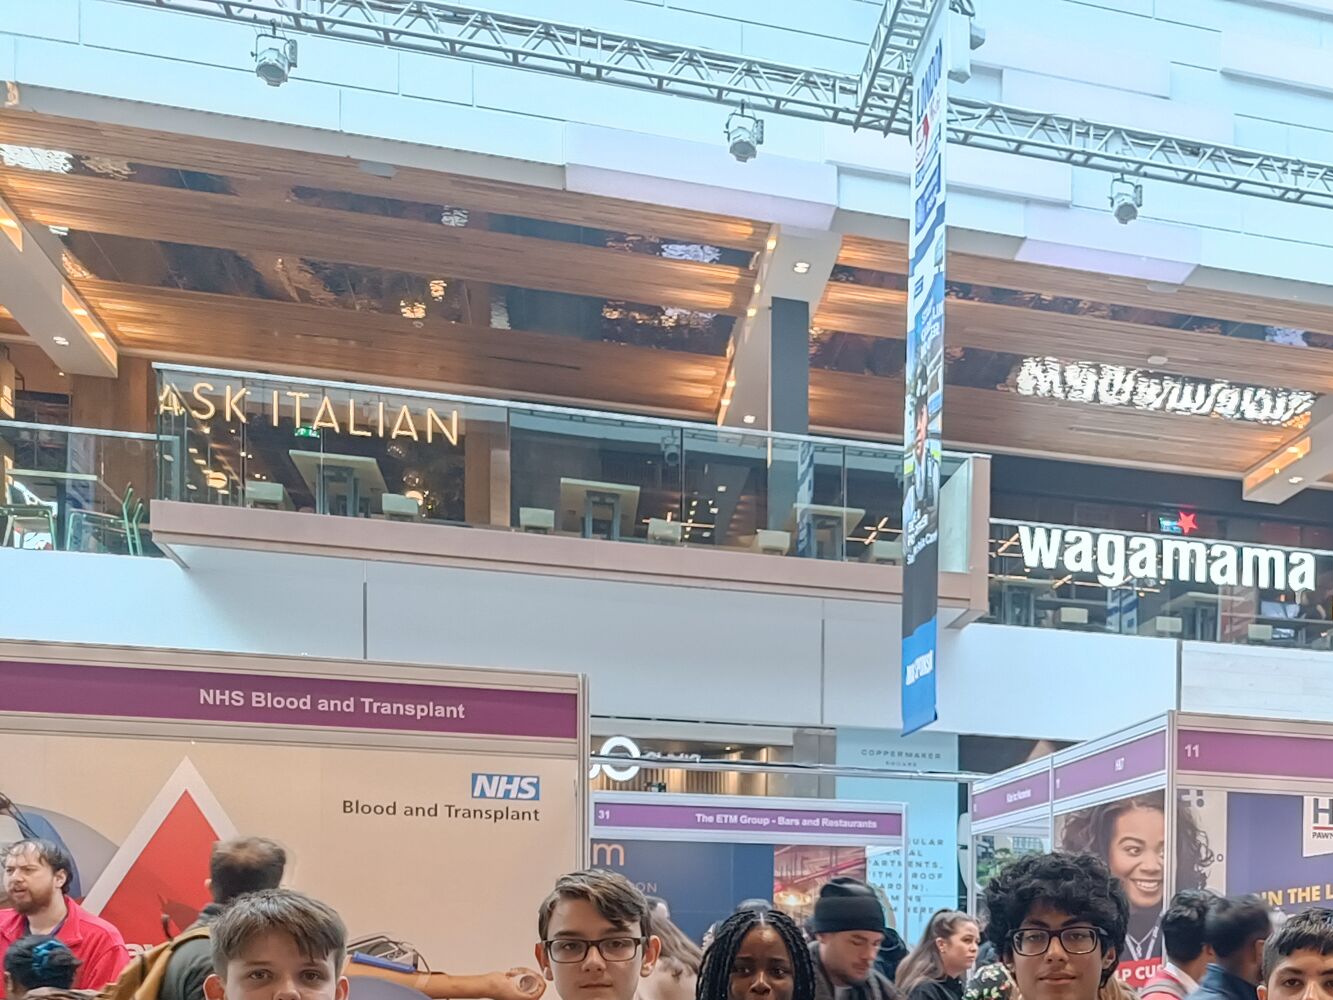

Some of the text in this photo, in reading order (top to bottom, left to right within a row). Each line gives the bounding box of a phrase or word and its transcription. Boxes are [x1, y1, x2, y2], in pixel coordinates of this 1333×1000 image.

[272, 390, 458, 446] ITALIAN
[1018, 524, 1316, 591] wagamama
[199, 688, 465, 720] NHS Blood and Transplant
[861, 749, 942, 760] COPPERMAKER
[1184, 744, 1200, 758] 11
[473, 775, 539, 799] NHS
[342, 800, 540, 823] Blood and Transplant
[696, 813, 713, 823] The
[716, 814, 738, 824] ETM
[740, 815, 770, 827] Group
[778, 816, 799, 826] Bars
[802, 817, 820, 827] and
[821, 818, 878, 829] Restaurants
[1287, 885, 1321, 904] THE
